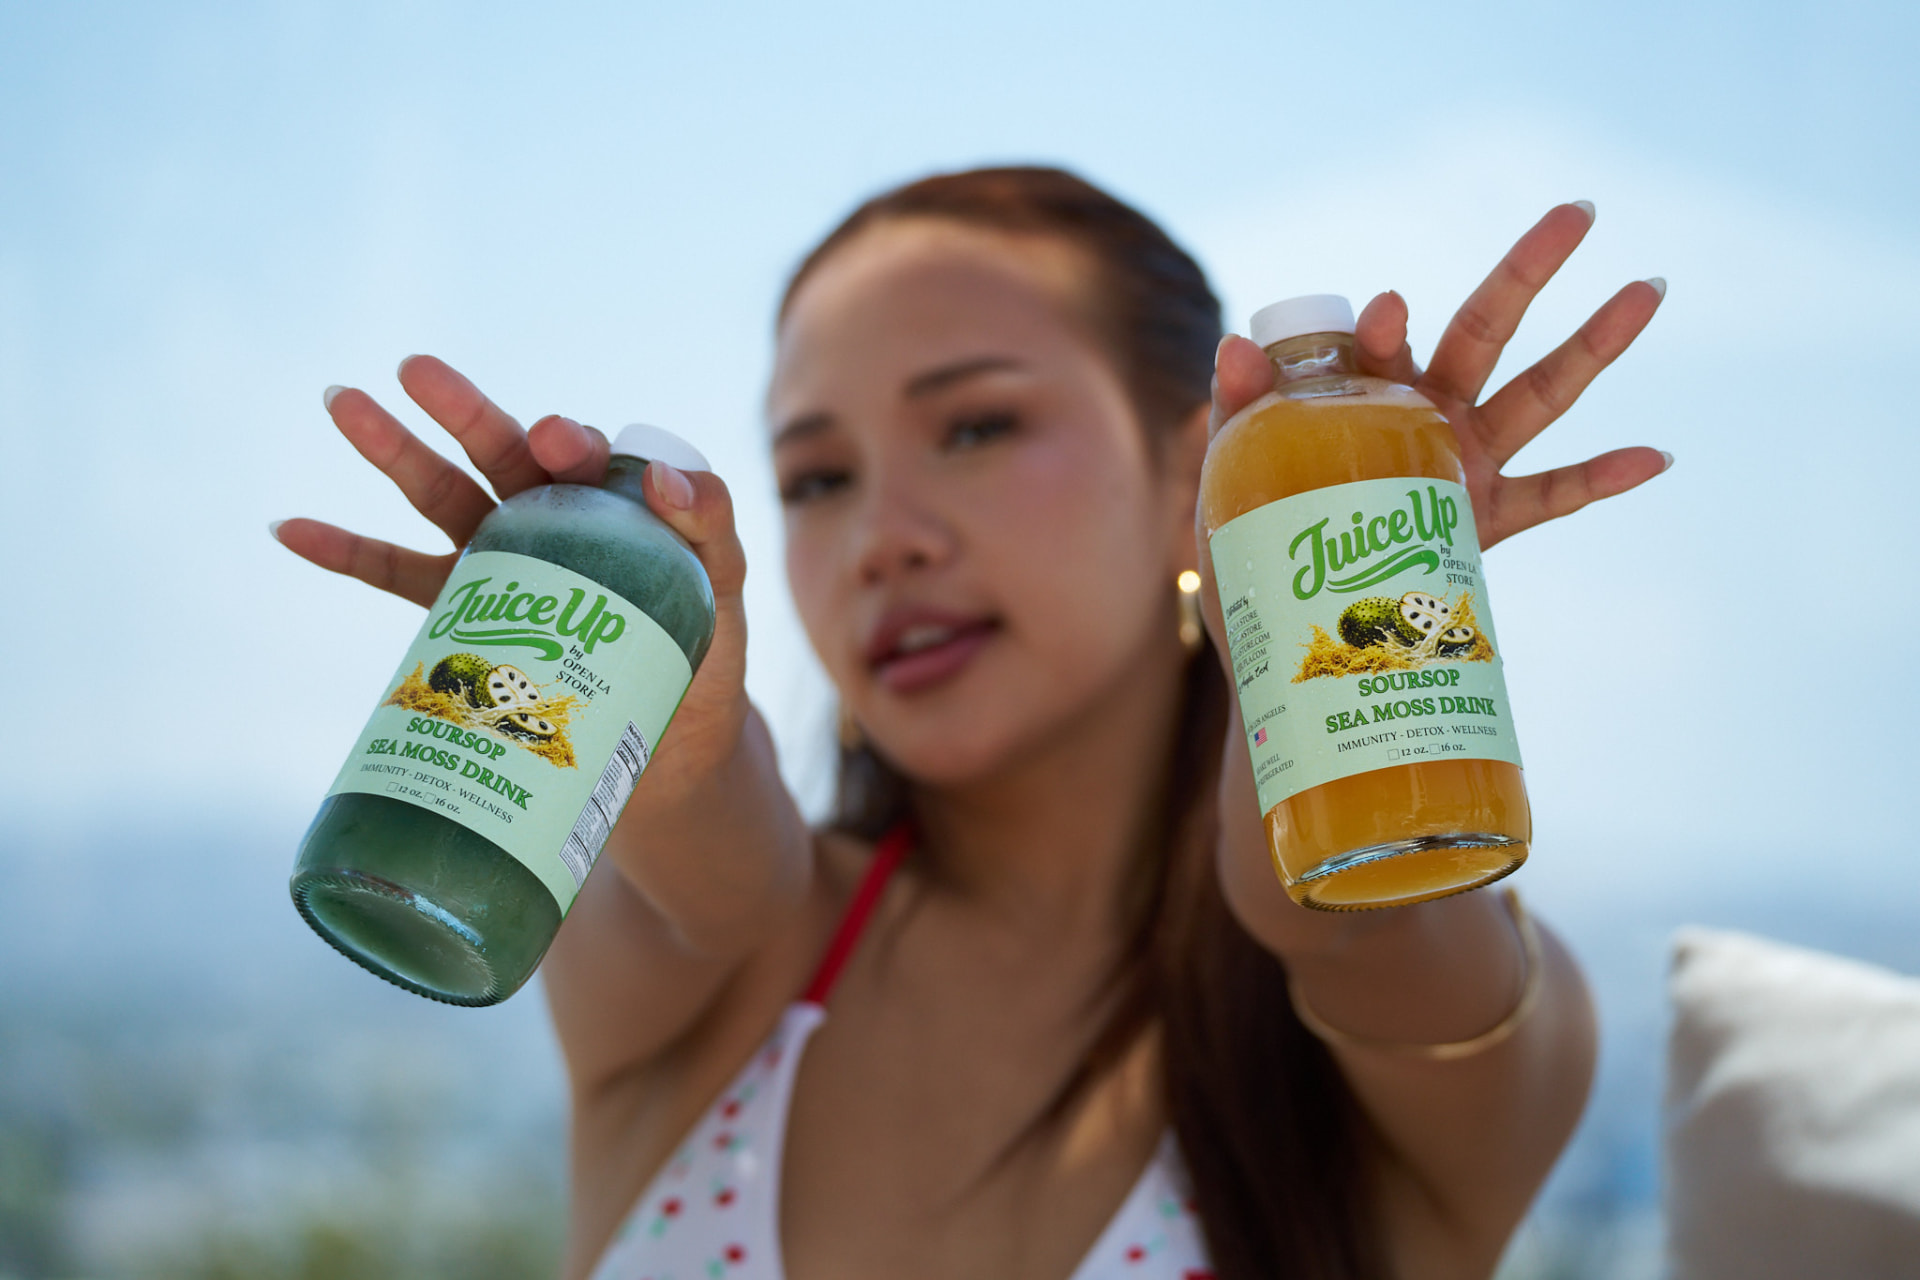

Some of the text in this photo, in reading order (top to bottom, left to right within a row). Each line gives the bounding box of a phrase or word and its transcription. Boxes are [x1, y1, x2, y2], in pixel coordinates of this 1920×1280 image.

[1440, 544, 1451, 558] by
[1443, 559, 1477, 574] OPEN LA
[1446, 573, 1474, 587] STORE
[1240, 609, 1259, 627] STORE
[569, 644, 584, 660] by
[556, 670, 597, 700] STORE
[563, 658, 610, 695] OPEN LA
[1358, 669, 1460, 697] SOURSOP
[1261, 704, 1286, 723] ANGELES
[1325, 697, 1497, 734] SEA MOSS DRINK
[406, 716, 507, 761] SOURSOP
[1337, 725, 1497, 753] IMMUNITY DETOX WELLNESS
[1401, 743, 1466, 757] 12 oz. 16 oz.
[366, 738, 533, 811] SEA MOSS DRINK
[360, 763, 514, 824] IMMUNITY DETOX WELLNESS
[398, 785, 461, 814] 12 oz. 16 oz.
